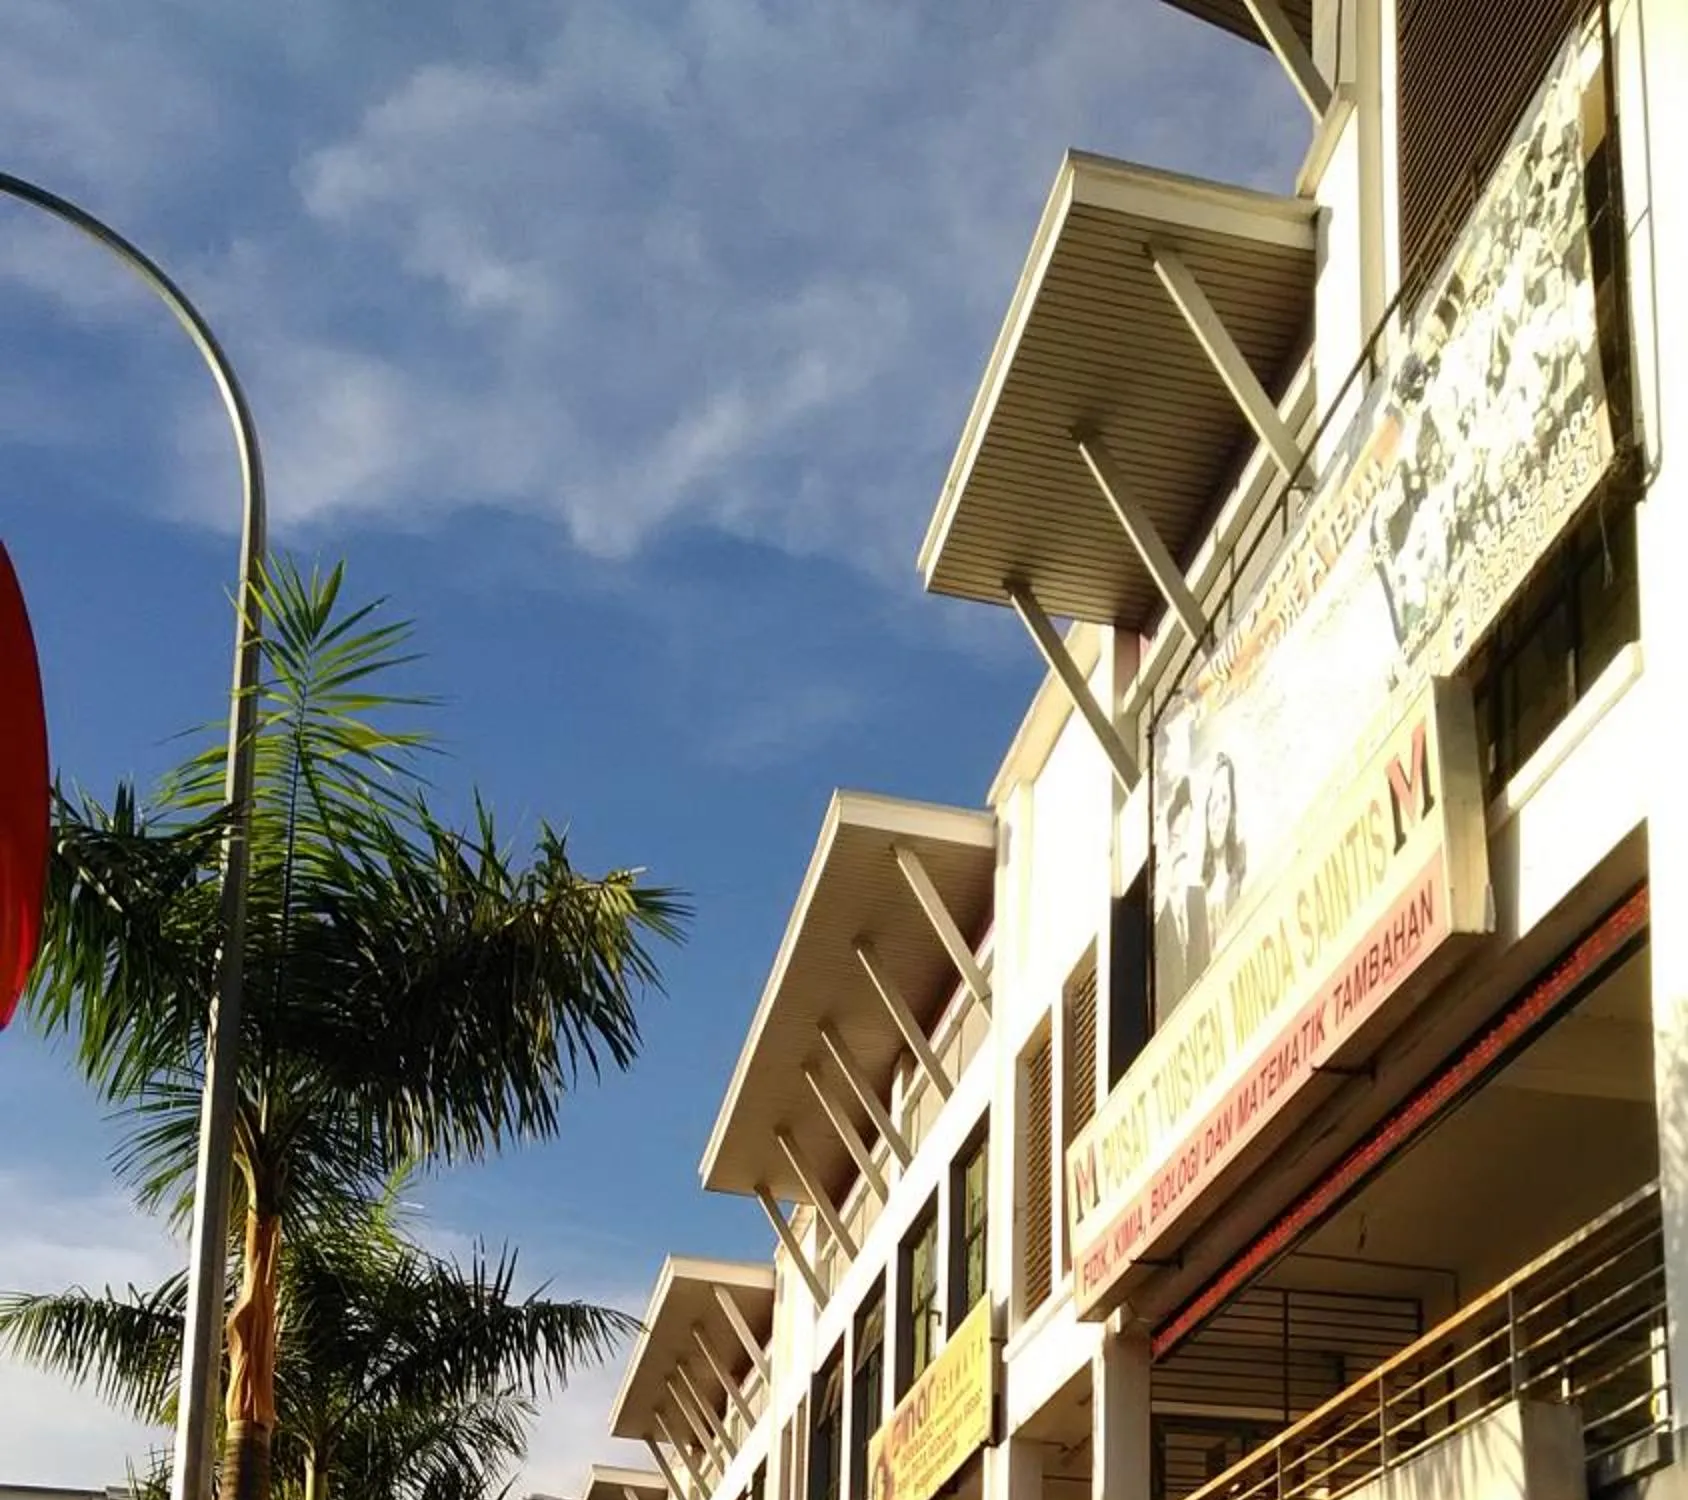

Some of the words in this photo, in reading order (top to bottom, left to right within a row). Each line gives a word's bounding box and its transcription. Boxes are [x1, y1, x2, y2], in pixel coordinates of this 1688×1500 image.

[1102, 1090, 1149, 1201] PUSAT
[1151, 998, 1227, 1142] TUISYEN
[1228, 913, 1296, 1052] MINDA
[1296, 799, 1389, 966] SAINTIS
[1387, 722, 1436, 857] M
[1149, 1144, 1201, 1224] BIOLOGI
[1202, 1108, 1234, 1168] DAN
[1234, 1001, 1328, 1131] MATEMATIK
[1331, 879, 1434, 1025] TAMBAHAN
